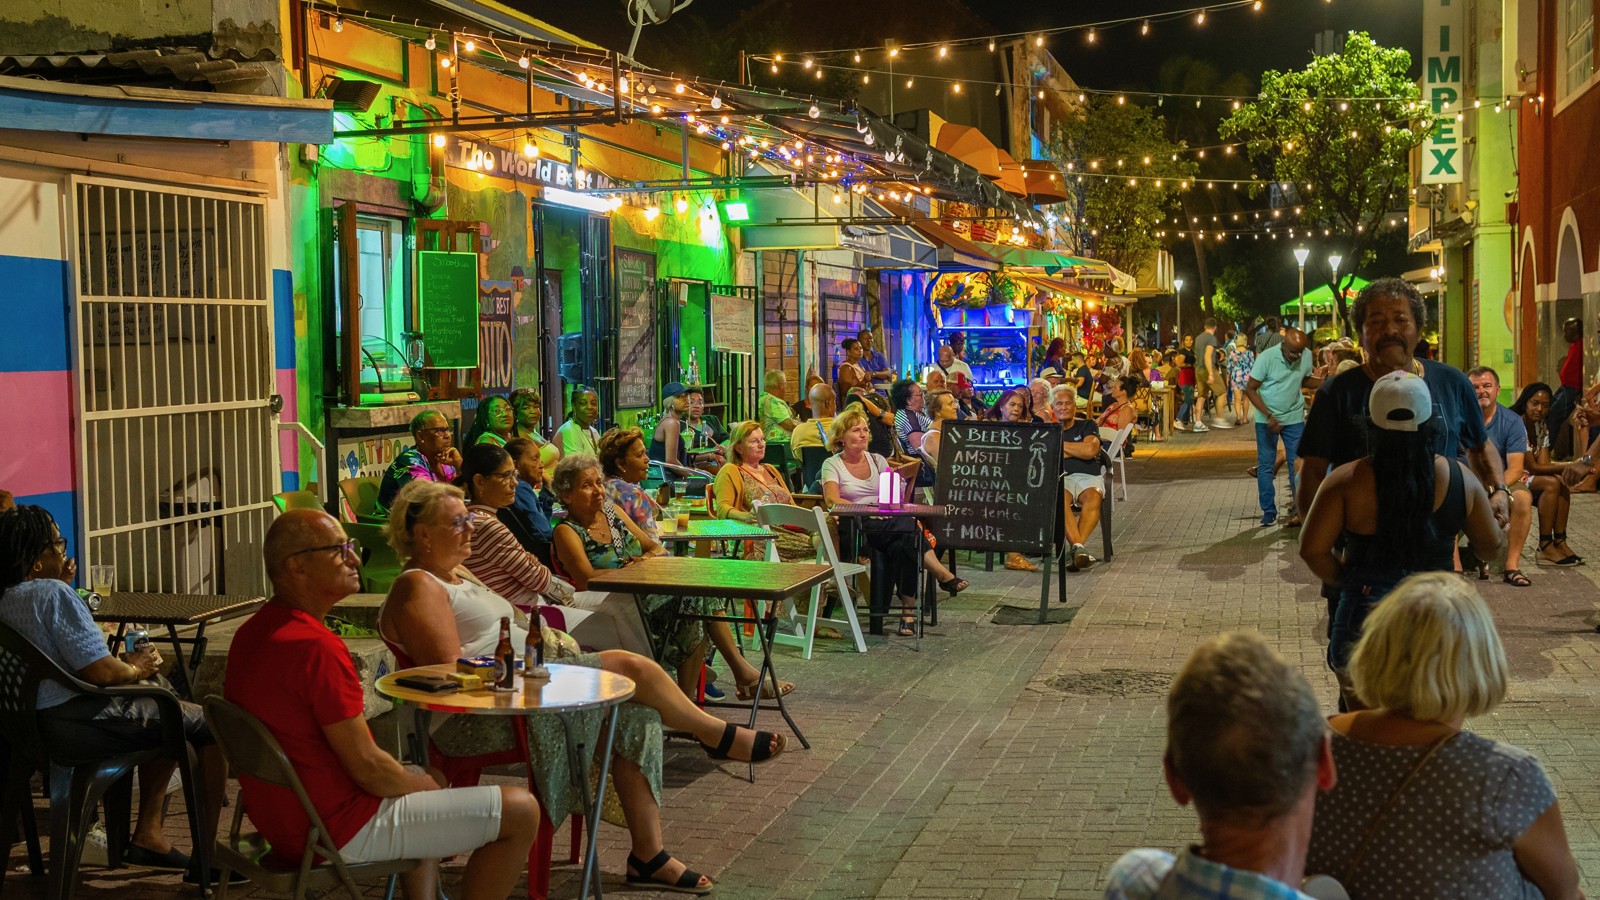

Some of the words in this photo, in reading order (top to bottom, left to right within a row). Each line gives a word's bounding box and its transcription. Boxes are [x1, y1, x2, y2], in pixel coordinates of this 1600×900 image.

[1427, 25, 1461, 176] IMPEX
[500, 149, 553, 183] World
[495, 297, 510, 315] BEST
[965, 427, 1023, 446] BEERS
[953, 449, 1012, 465] AMSTEL
[951, 464, 1003, 478] POLAR
[952, 477, 1011, 491] CORONA
[948, 488, 1030, 506] HEINEKEN
